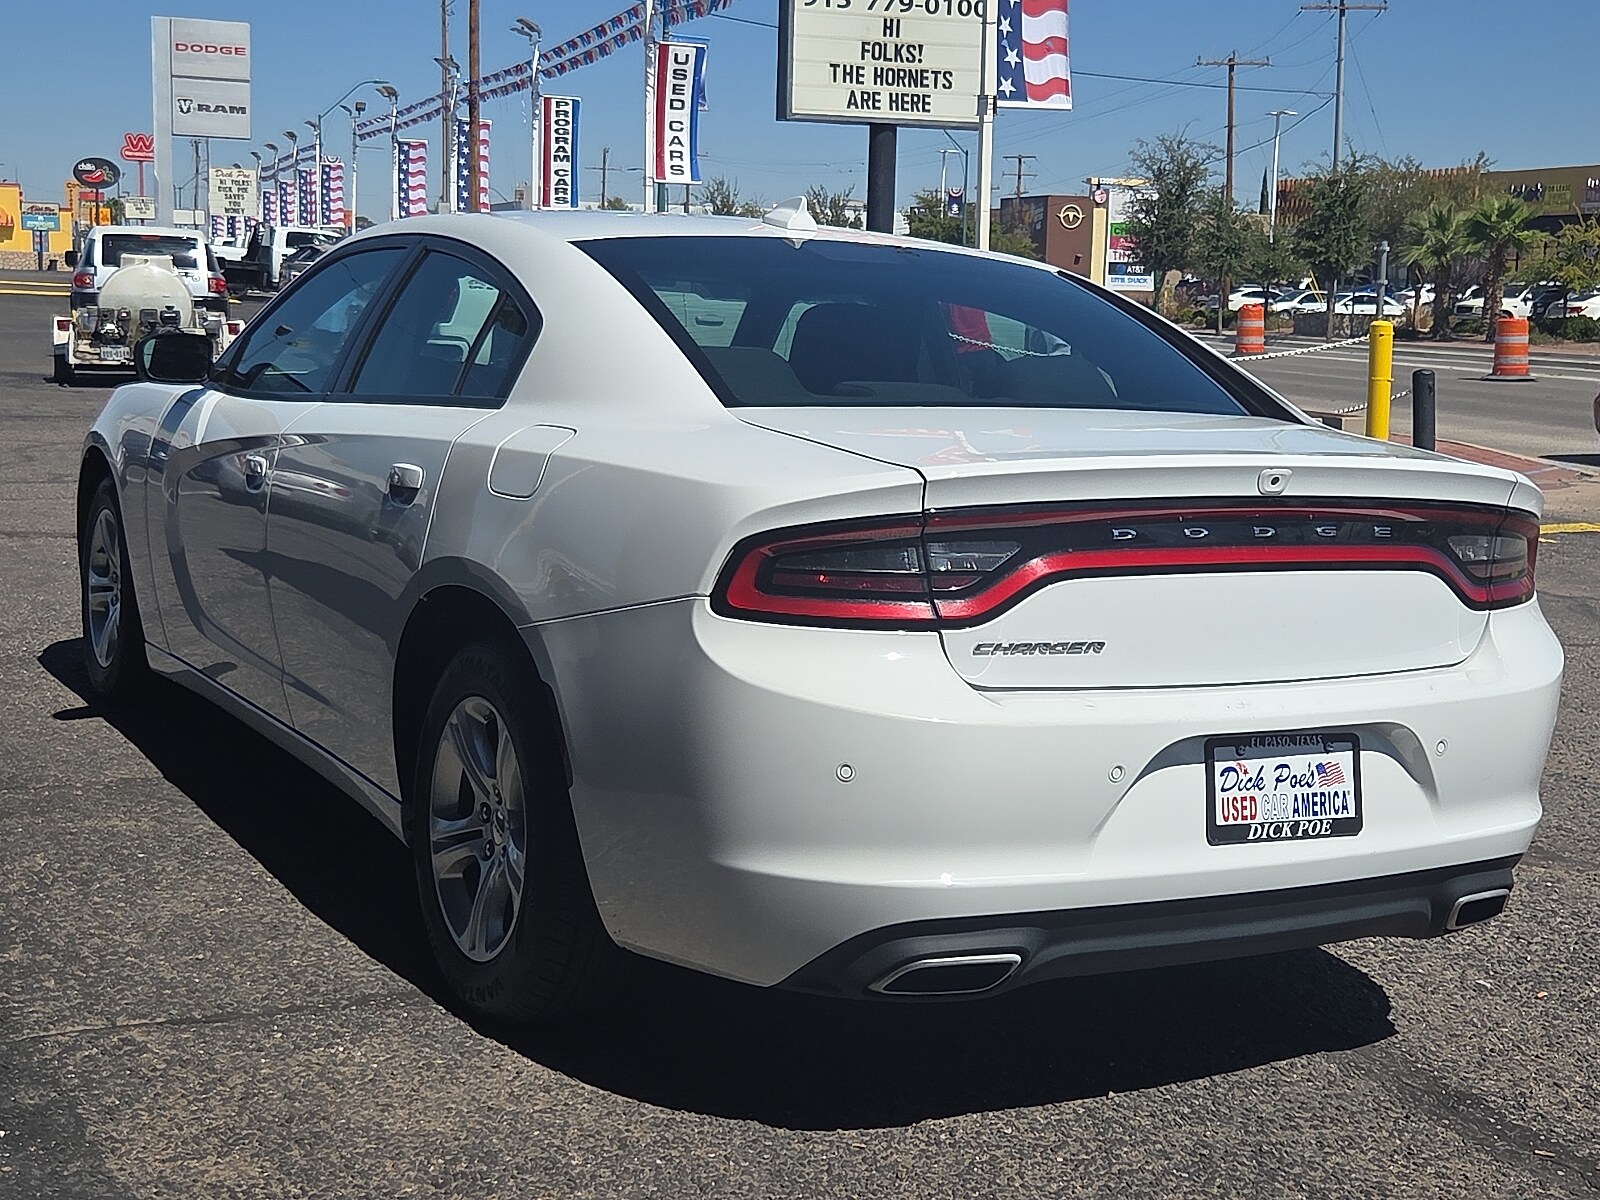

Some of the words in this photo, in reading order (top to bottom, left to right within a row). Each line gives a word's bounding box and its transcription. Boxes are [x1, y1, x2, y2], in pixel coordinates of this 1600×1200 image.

[883, 18, 901, 38] HI
[175, 43, 247, 56] DODGE
[860, 41, 924, 64] FOLKS!
[669, 52, 690, 111] USED
[829, 63, 866, 85] THE
[873, 67, 954, 90] HORNETS
[197, 103, 247, 115] RAM
[846, 90, 881, 111] ARE
[889, 92, 932, 114] HERE
[554, 100, 571, 163] PROGRAM
[668, 120, 686, 176] CARS
[553, 169, 570, 205] CARS
[1126, 265, 1146, 274] AT&T
[1112, 525, 1393, 541] DODGE
[972, 641, 1106, 657] CHARGER
[1251, 737, 1262, 747] EL
[1296, 735, 1323, 746] TEXAS
[1219, 765, 1266, 793] Dick
[1273, 762, 1317, 791] Poe's
[1221, 796, 1258, 822] USED
[1261, 793, 1290, 820] CAR
[1292, 790, 1350, 818] AMERICA
[1247, 822, 1294, 840] DICK
[1295, 819, 1333, 836] POE
